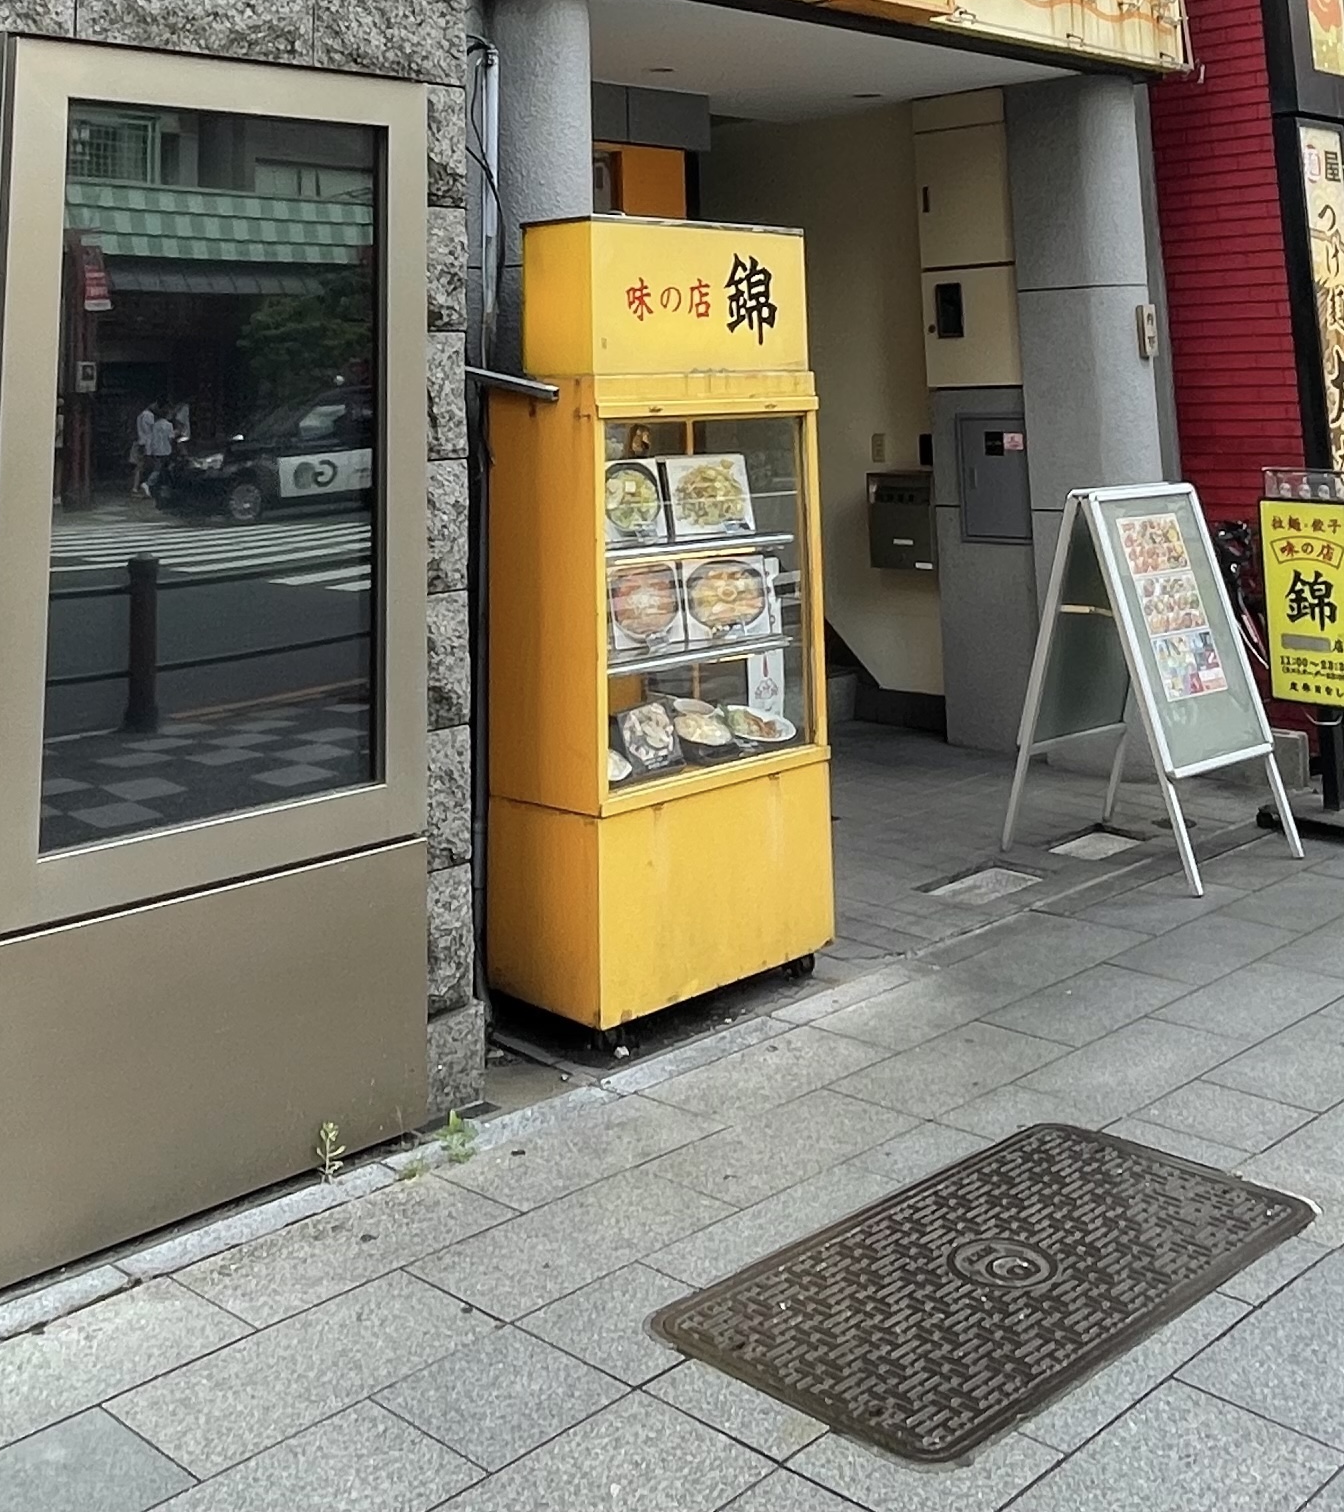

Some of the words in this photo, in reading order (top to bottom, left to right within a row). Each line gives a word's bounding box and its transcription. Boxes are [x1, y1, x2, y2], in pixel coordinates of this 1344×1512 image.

[627, 276, 712, 323] 味の店
[724, 252, 779, 346] 錦
[1280, 540, 1336, 563] 味の店
[1285, 569, 1339, 632] 錦
